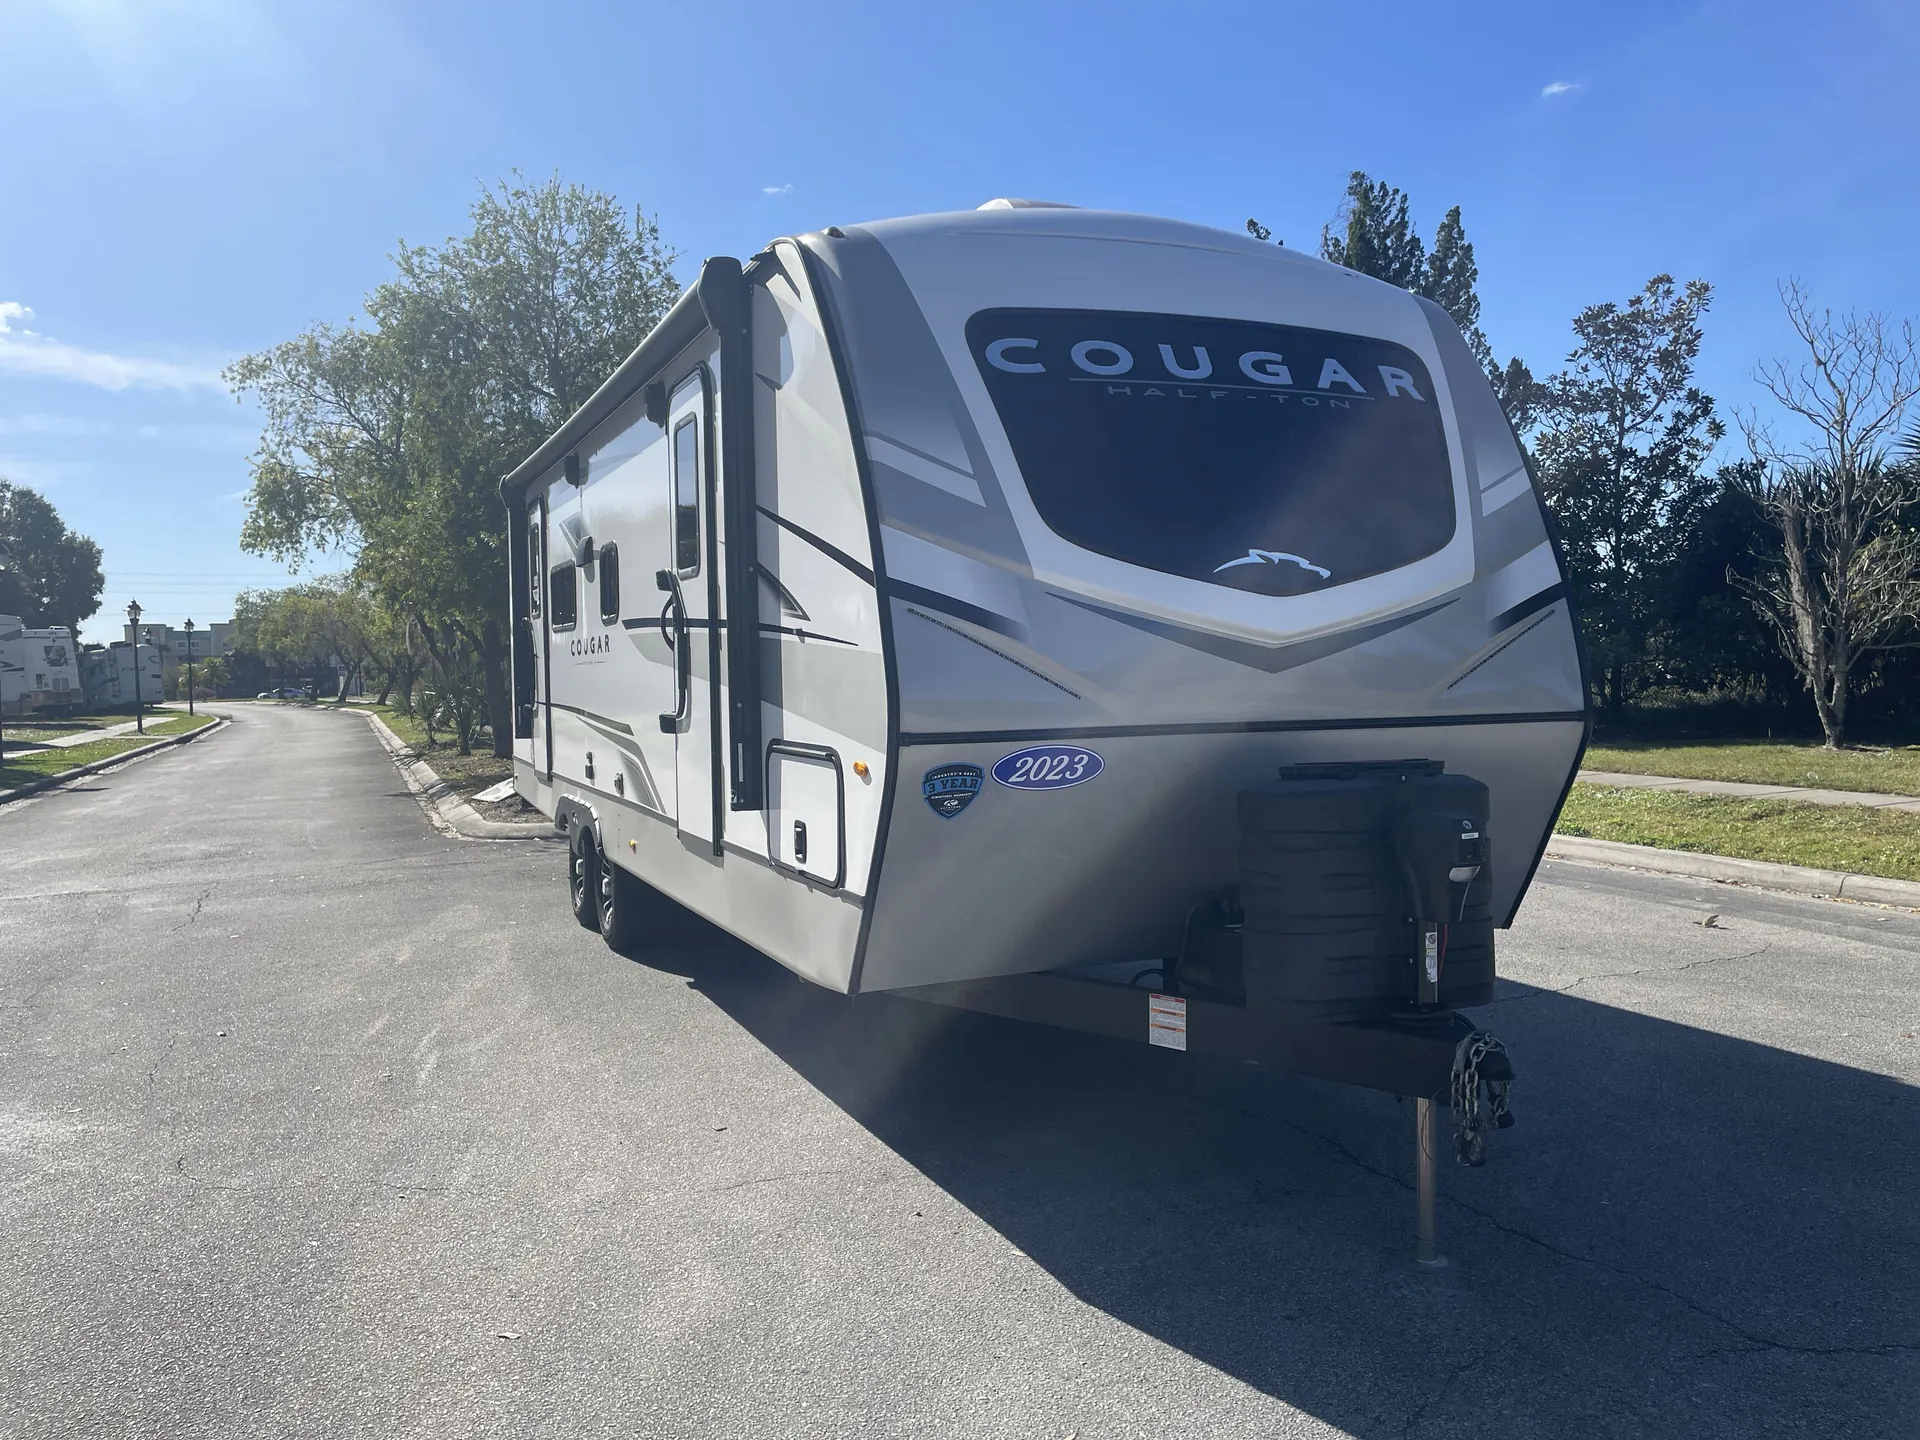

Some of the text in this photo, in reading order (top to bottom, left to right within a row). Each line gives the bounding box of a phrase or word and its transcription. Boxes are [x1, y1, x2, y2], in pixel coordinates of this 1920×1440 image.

[985, 338, 1426, 401] COUGAR
[570, 634, 610, 656] COUGAR
[1008, 754, 1089, 783] 2023
[927, 777, 979, 793] 3 YEAR
